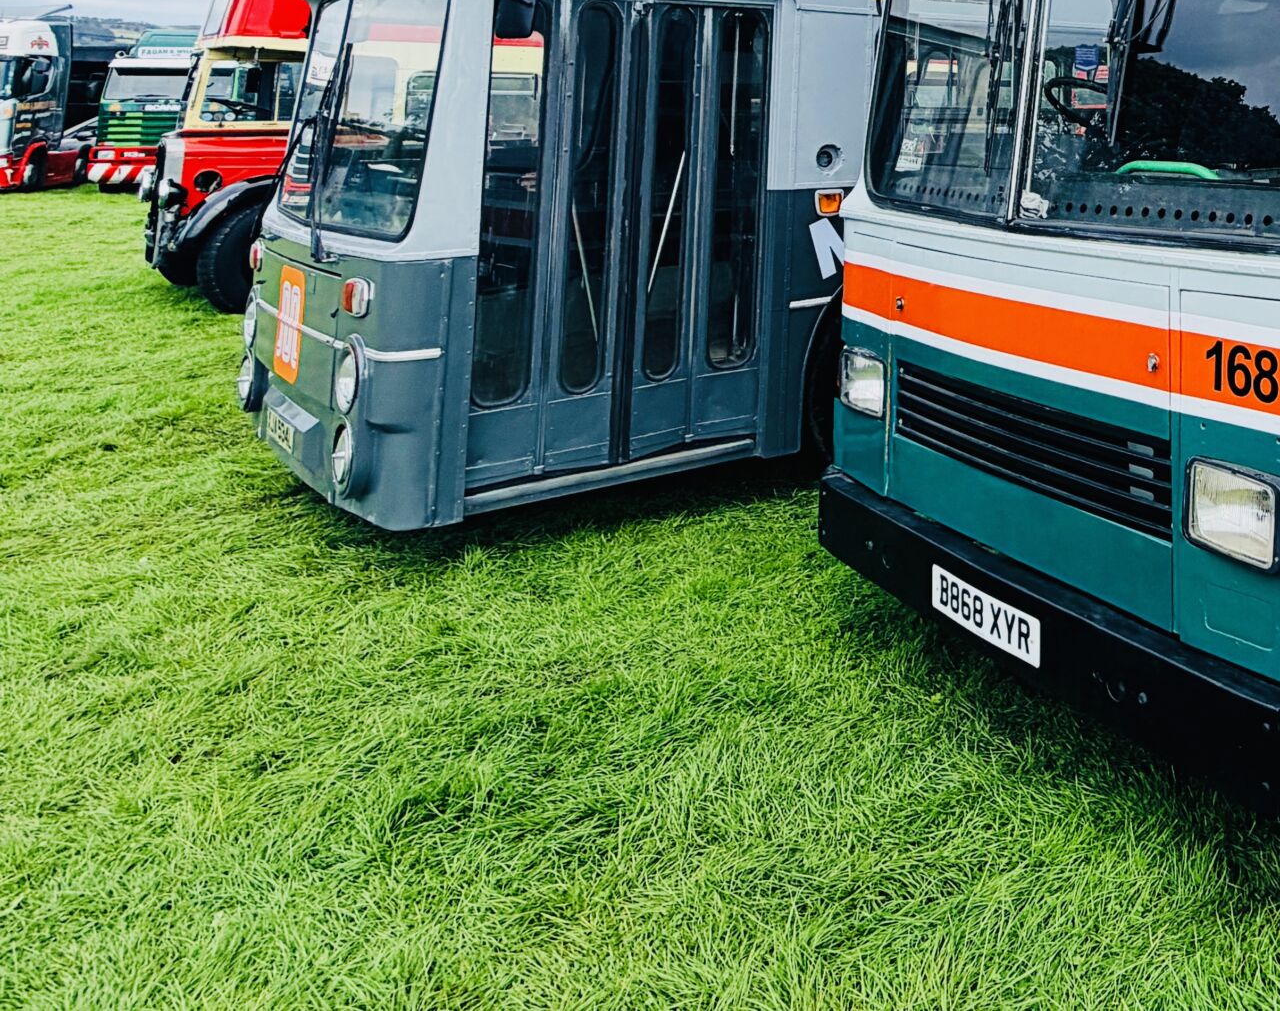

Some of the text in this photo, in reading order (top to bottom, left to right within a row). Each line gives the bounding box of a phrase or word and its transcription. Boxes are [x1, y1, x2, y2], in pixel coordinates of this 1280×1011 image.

[1205, 340, 1279, 404] 168
[940, 574, 1030, 655] B868 XYR
